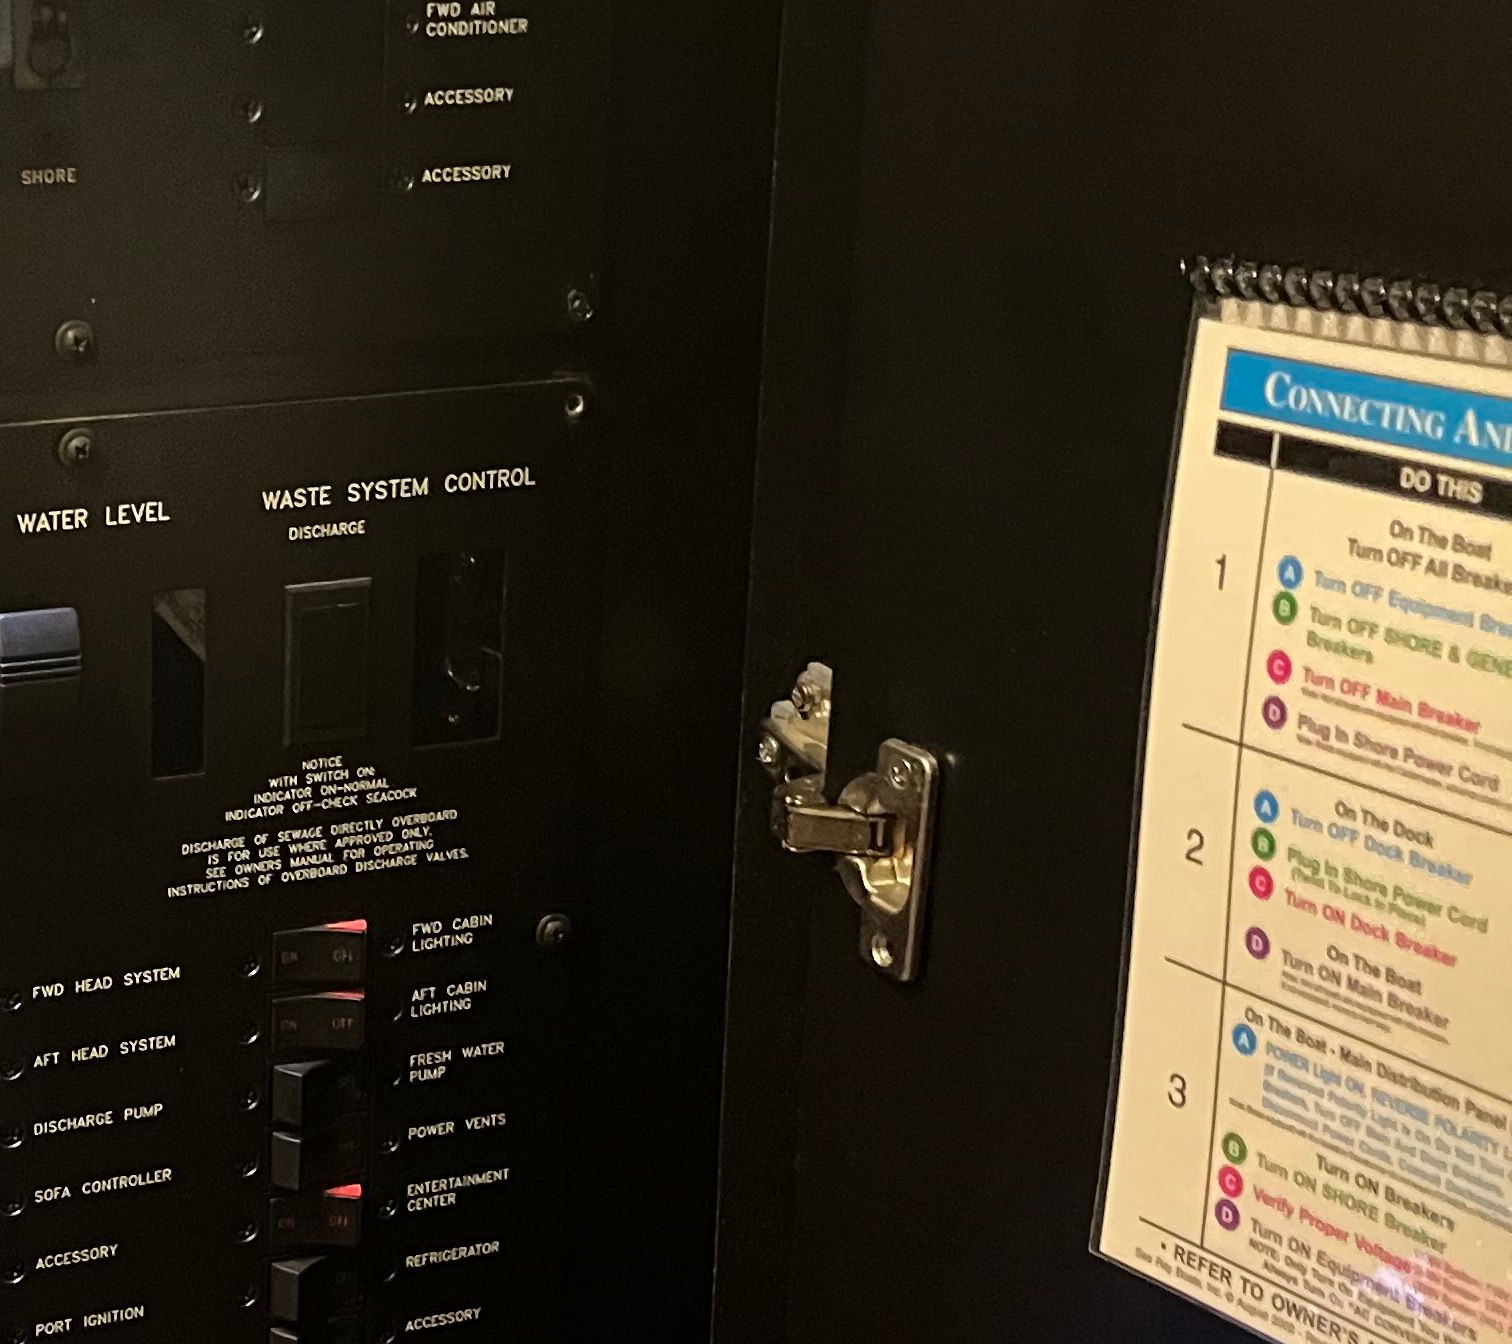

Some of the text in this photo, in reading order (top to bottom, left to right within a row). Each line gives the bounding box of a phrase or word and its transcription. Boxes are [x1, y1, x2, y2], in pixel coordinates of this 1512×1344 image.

[427, 1, 495, 17] FWD AIR
[426, 19, 527, 36] CONDITIONER
[425, 88, 513, 105] ACCESSORY
[22, 168, 76, 184] SHORE
[422, 165, 510, 182] ACCESSORY
[263, 467, 535, 510] WASTE SYSTEM CONTROL
[1400, 467, 1483, 504] DO THIS
[17, 502, 170, 533] WATER LEVEL
[289, 520, 365, 540] DISCHARGE
[1215, 553, 1229, 592] 1
[303, 756, 342, 770] NOTICE
[1184, 827, 1205, 865] 2
[413, 914, 492, 935] FWD CABIN
[413, 933, 472, 951] LIGHTING
[33, 967, 180, 998] FWD HEAD SYSTEM
[412, 980, 486, 1001] AFT CABIN
[411, 998, 471, 1017] LIGHTING
[34, 1035, 175, 1067] AFT HEAD SYSTEM
[410, 1042, 504, 1066] FRESH WATER
[410, 1066, 445, 1081] PUMP
[1167, 1073, 1187, 1109] 3
[34, 1104, 163, 1135] DISCHARGE PUMP
[408, 1113, 505, 1140] POWER VENTS
[35, 1168, 171, 1203] SOFA CONTROLLER
[408, 1168, 509, 1196] ENTERTAINMENT
[408, 1193, 455, 1211] CENTER
[36, 1244, 117, 1269] ACCESSORY
[406, 1241, 499, 1267] REFRIGERATOR
[1172, 1246, 1232, 1285] REFER
[1240, 1276, 1264, 1301] TO
[36, 1306, 144, 1336] PORT IGNITION
[405, 1308, 481, 1331] ACCESSORY
